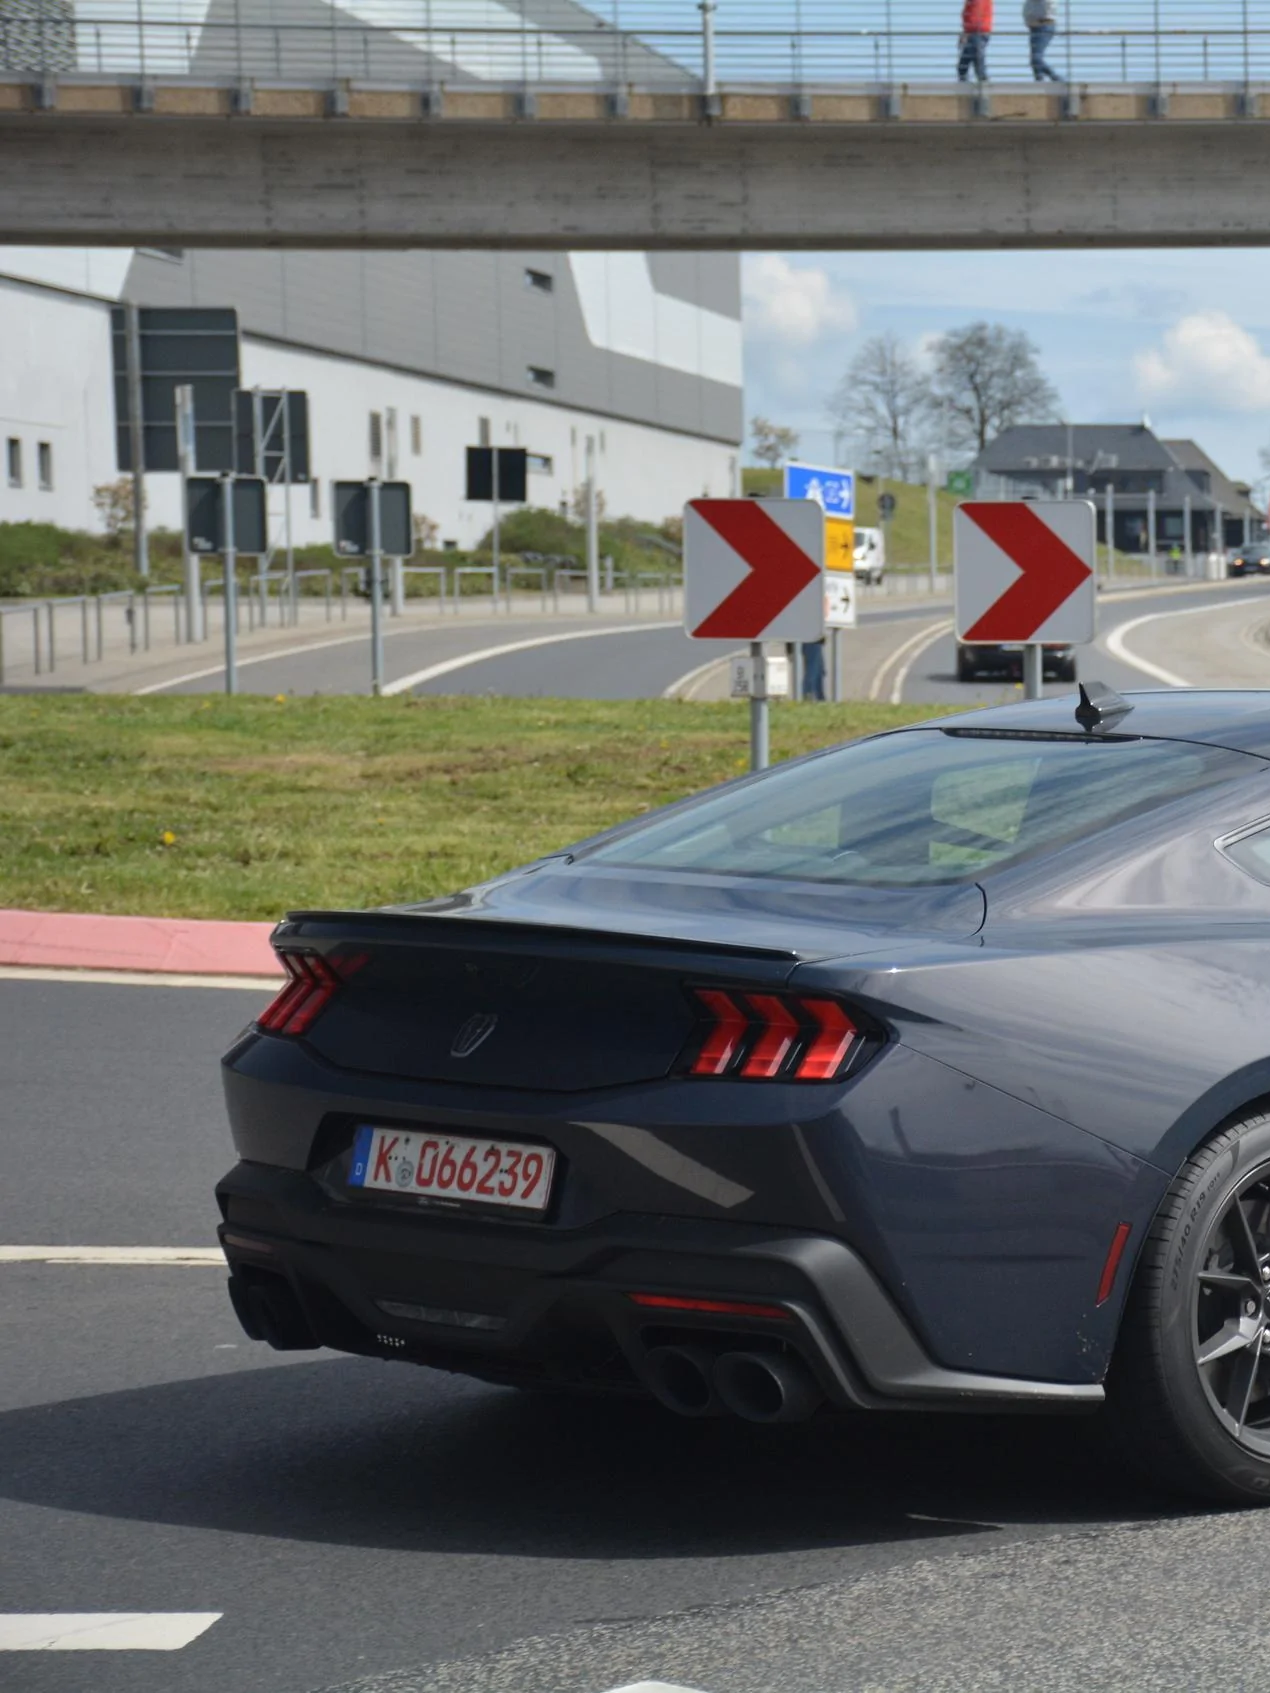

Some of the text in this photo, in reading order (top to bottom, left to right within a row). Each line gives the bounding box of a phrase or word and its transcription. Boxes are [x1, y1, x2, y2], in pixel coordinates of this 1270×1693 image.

[354, 1161, 363, 1176] D
[373, 1135, 544, 1199] K 066239
